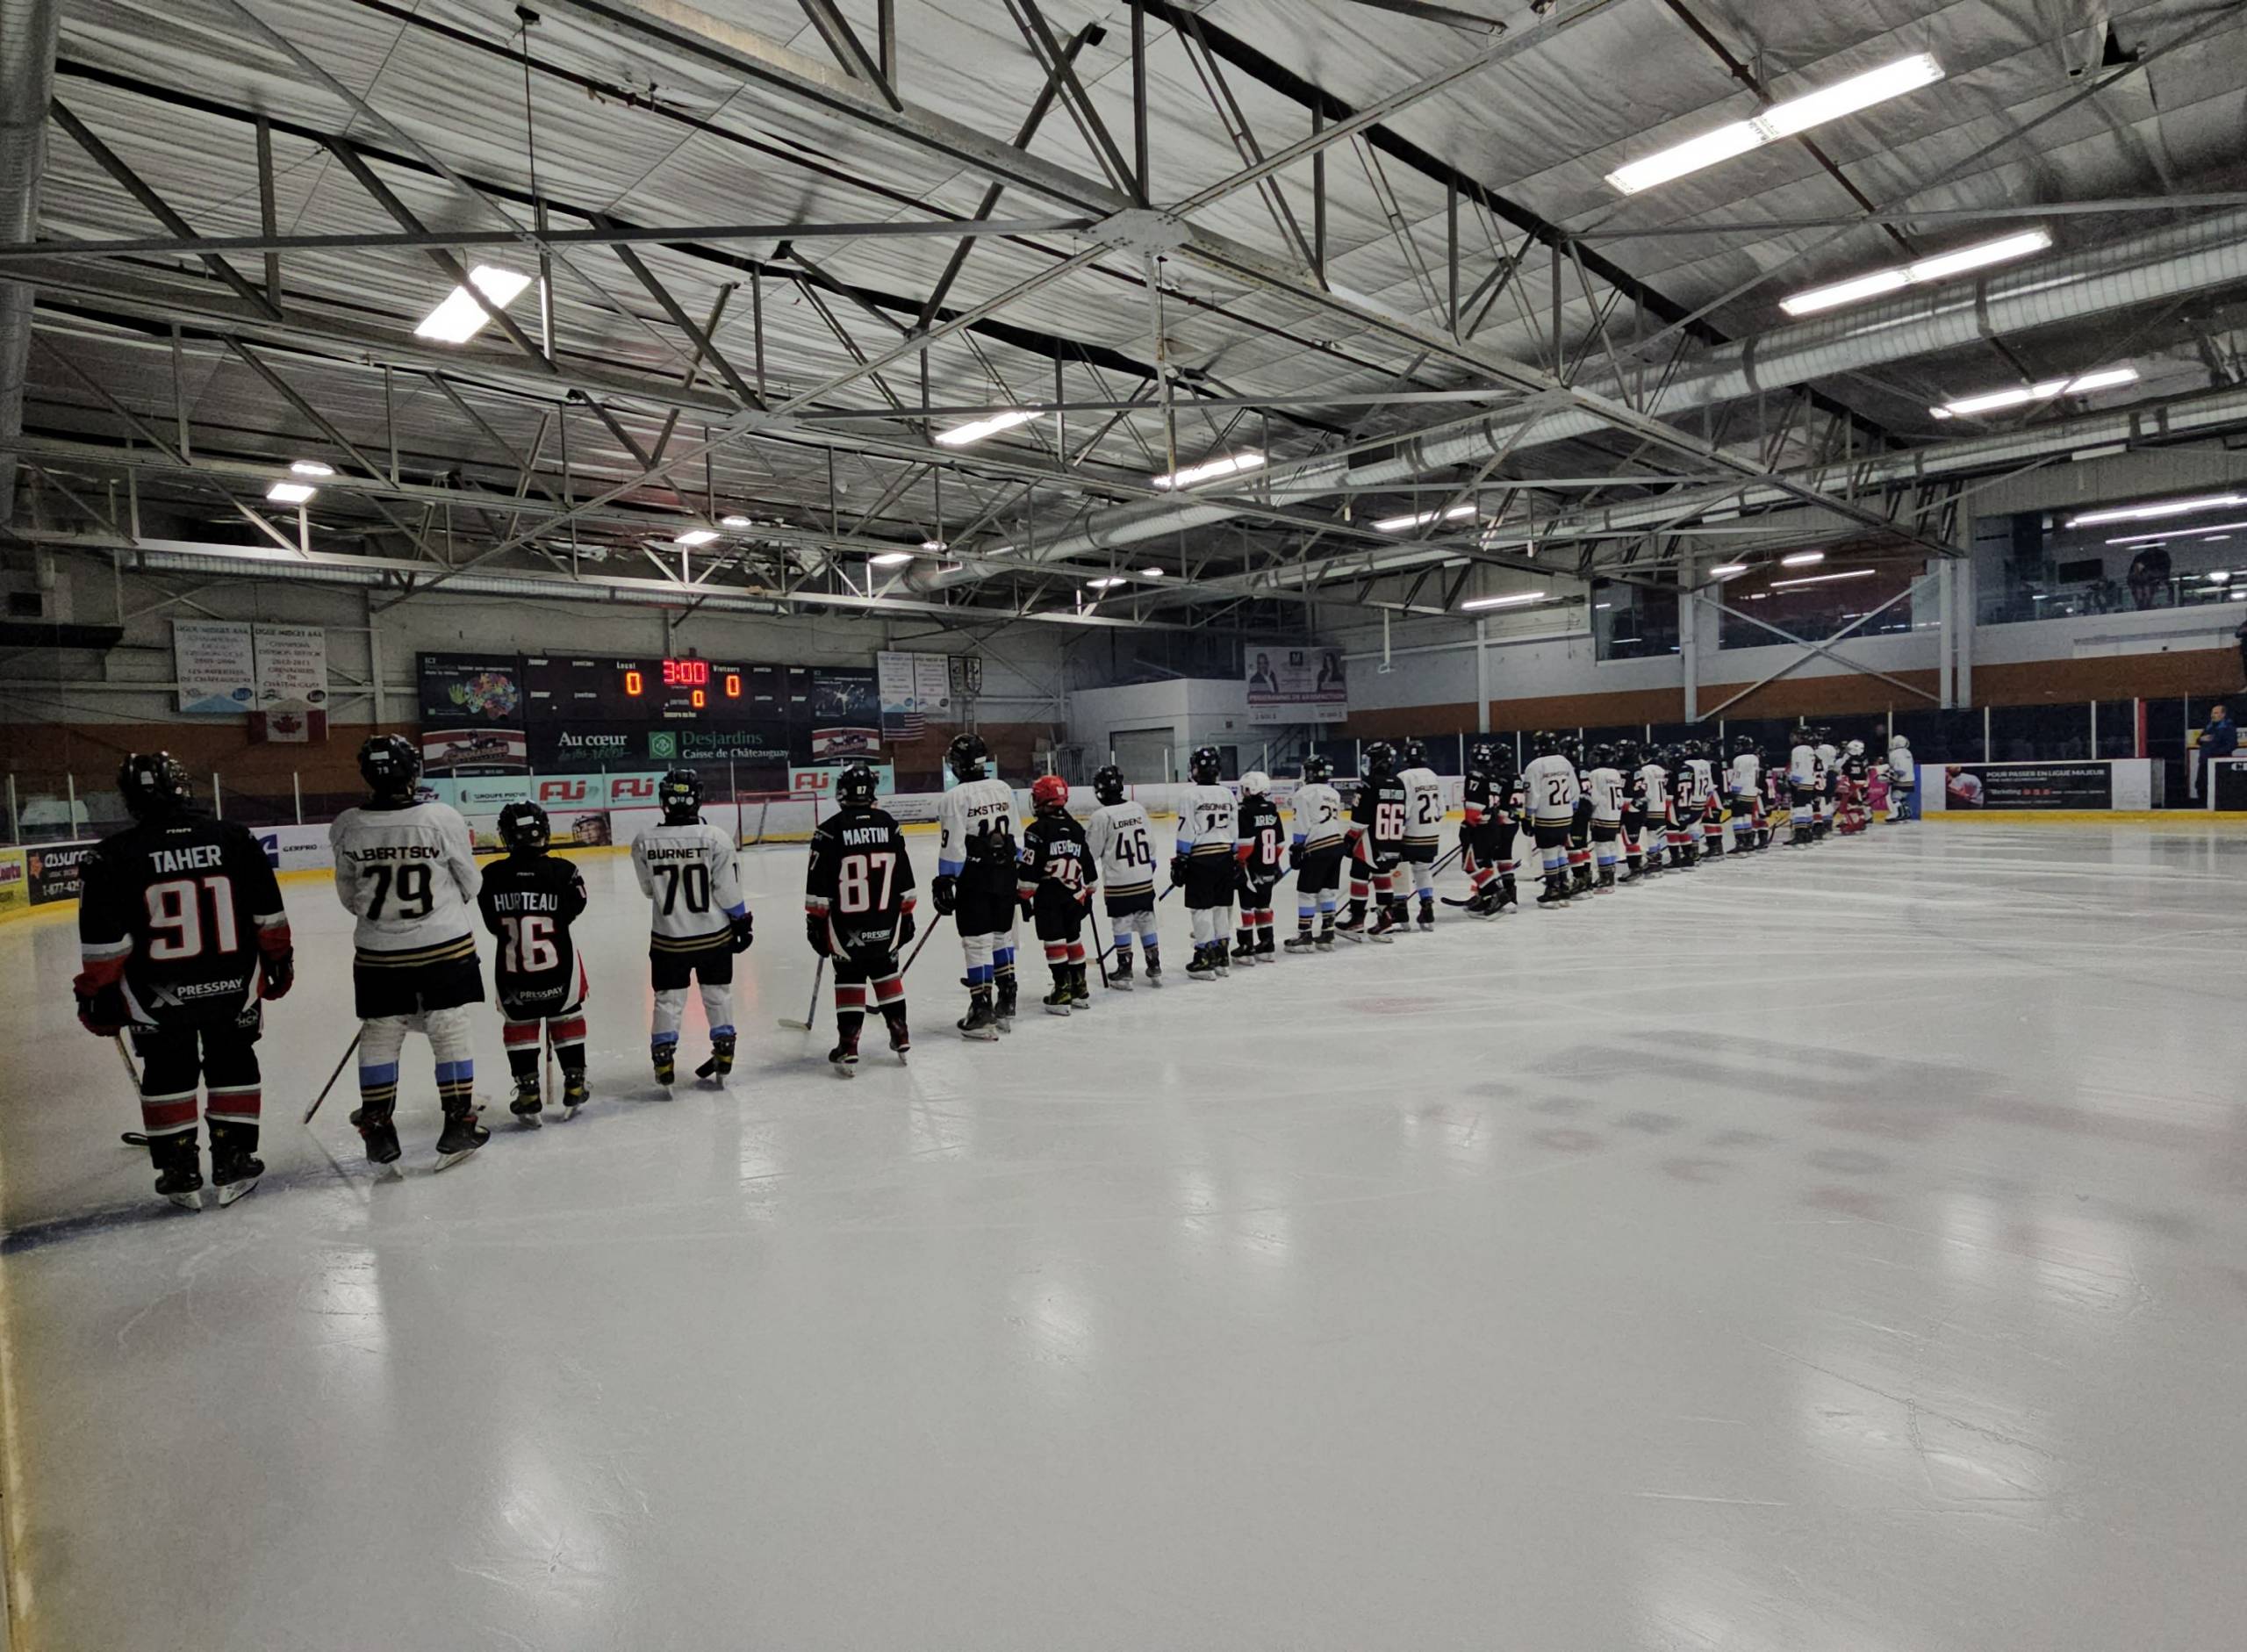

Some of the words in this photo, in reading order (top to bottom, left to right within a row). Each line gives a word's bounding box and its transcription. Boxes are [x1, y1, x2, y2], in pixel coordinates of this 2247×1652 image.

[626, 672, 642, 694] 0
[663, 660, 706, 684] 3:00
[726, 674, 740, 696] 0
[693, 689, 704, 707] 0
[557, 731, 583, 746] Au
[682, 730, 763, 749] Desjardins
[683, 749, 714, 758] Caisse
[716, 748, 728, 758] de
[730, 748, 789, 760] Châteauguay
[1375, 802, 1404, 840] 66
[843, 826, 889, 846] MARTIN
[1116, 828, 1151, 868] 46
[1261, 828, 1276, 865] 8
[148, 844, 223, 873] TAHER
[363, 863, 434, 921] 79
[652, 863, 709, 916] 70
[839, 852, 896, 913] 87
[493, 892, 558, 912] HURTEAU
[144, 874, 239, 962] 91
[501, 915, 559, 973] 16
